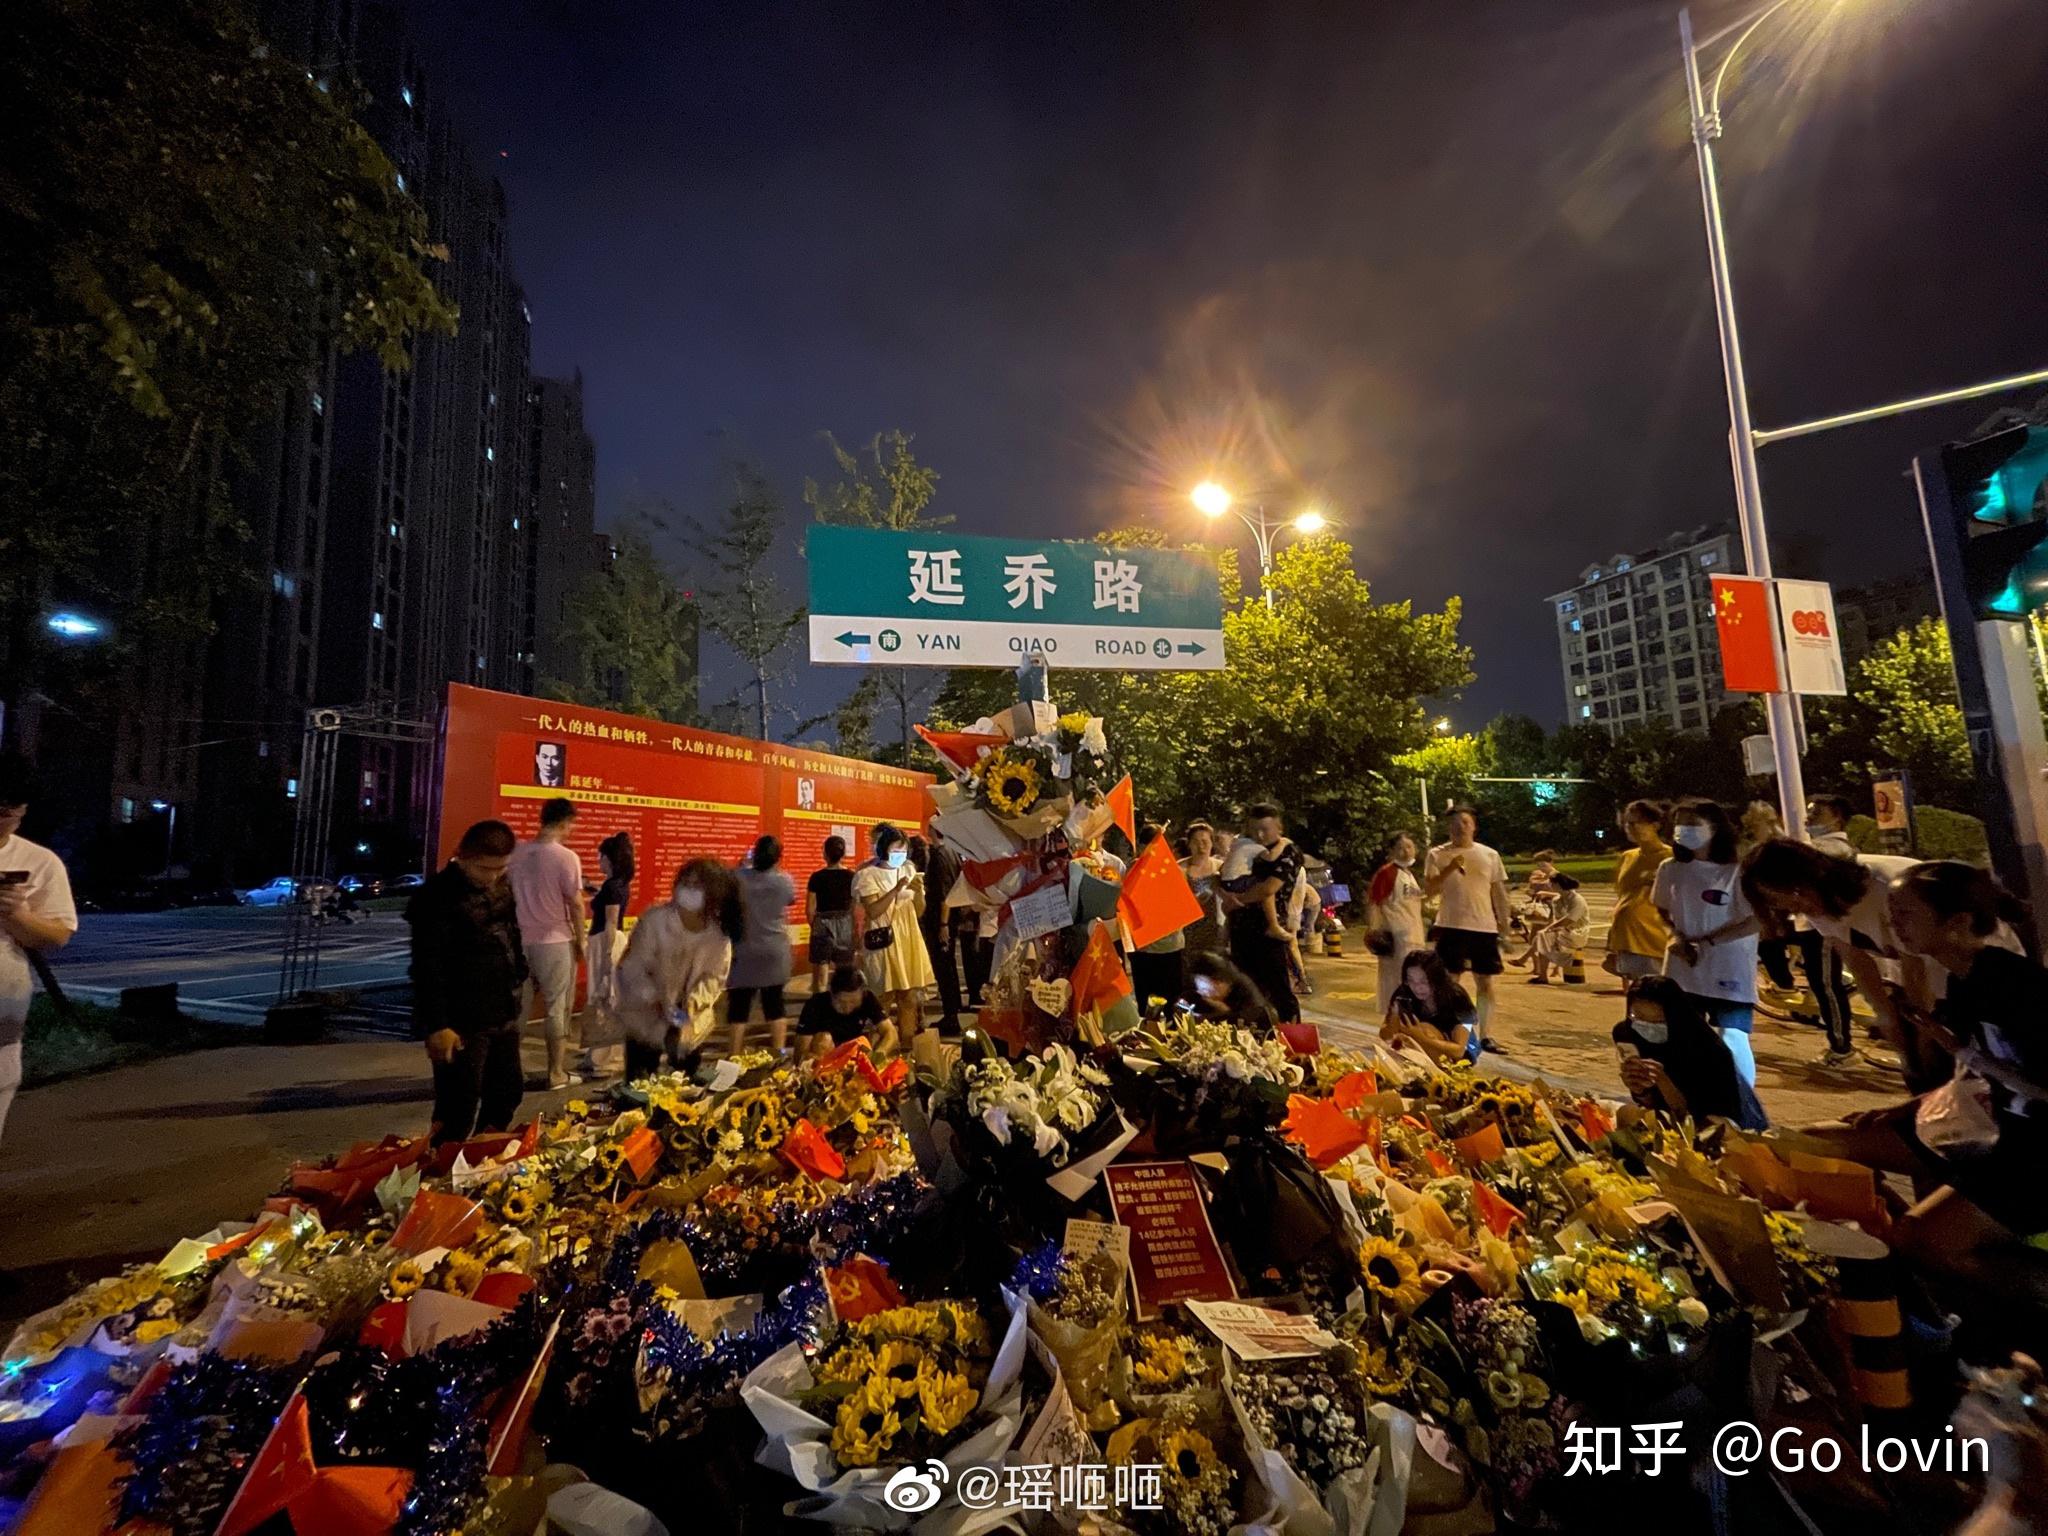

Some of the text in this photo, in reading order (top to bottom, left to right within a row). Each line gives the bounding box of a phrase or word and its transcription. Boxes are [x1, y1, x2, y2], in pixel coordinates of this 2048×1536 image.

[907, 549, 1143, 613] 延乔路
[881, 631, 1170, 657] 南 YAN QIAO ROAD 北
